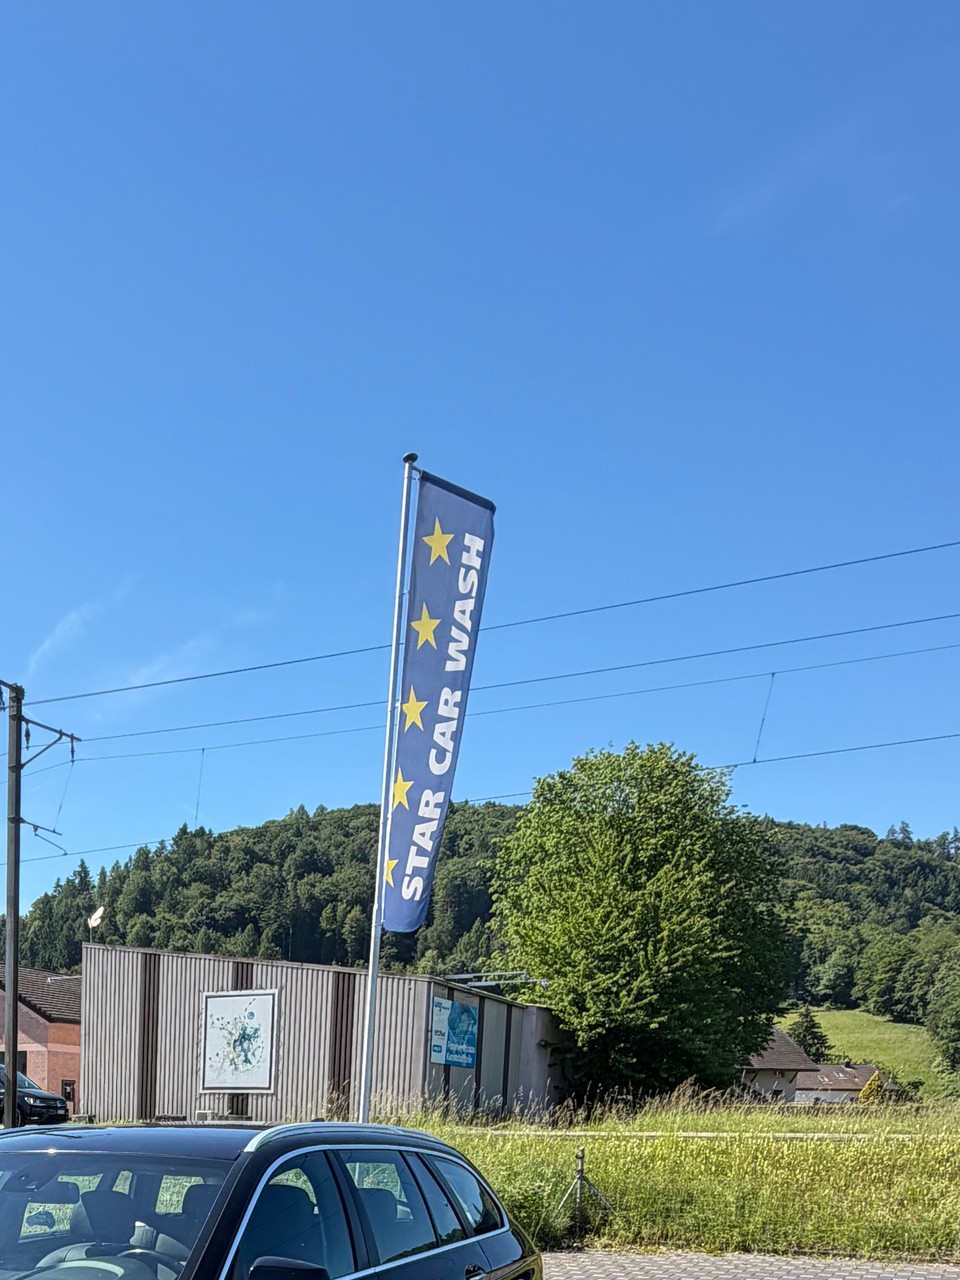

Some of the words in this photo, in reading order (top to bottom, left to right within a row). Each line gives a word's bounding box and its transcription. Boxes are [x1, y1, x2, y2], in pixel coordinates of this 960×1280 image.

[444, 532, 485, 672] WASH
[428, 686, 462, 776] CAR
[400, 787, 445, 901] STAR
